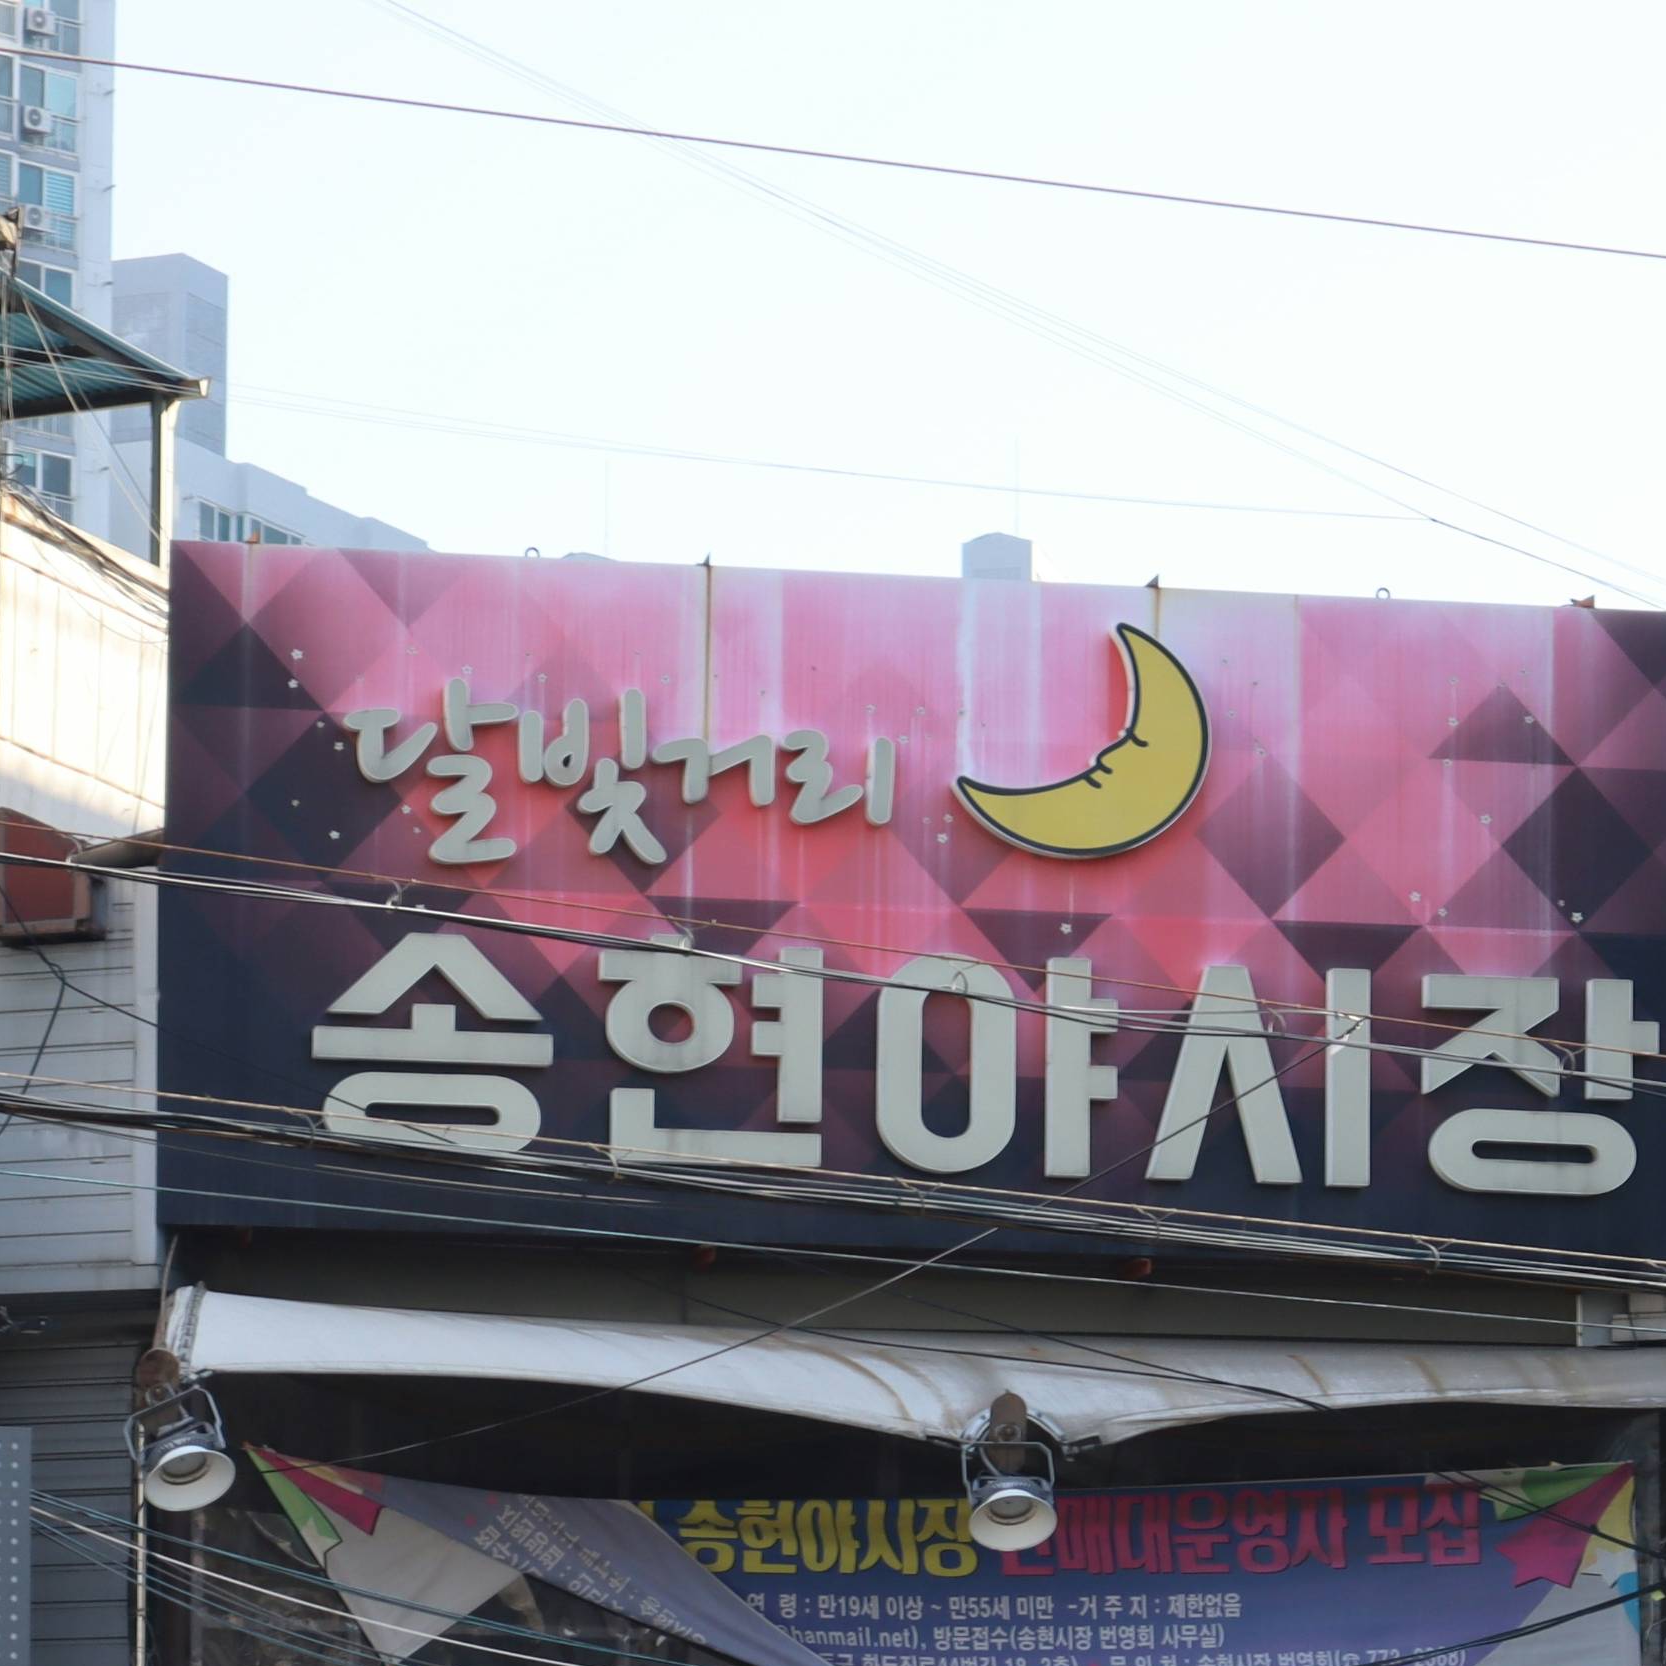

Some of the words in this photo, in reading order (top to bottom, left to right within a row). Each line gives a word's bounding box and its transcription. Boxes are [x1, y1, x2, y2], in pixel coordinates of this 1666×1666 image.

[341, 676, 895, 868] 달빛거리
[311, 932, 1661, 1197] 송현야시장
[677, 1498, 981, 1578] 송현야시장
[1368, 1484, 1483, 1567] 모집
[818, 1595, 880, 1619] 만19세
[886, 1596, 925, 1620] 이상
[949, 1597, 1010, 1620] 만55세
[1017, 1597, 1055, 1620] 미만
[1161, 1622, 1225, 1650] 사무실)
